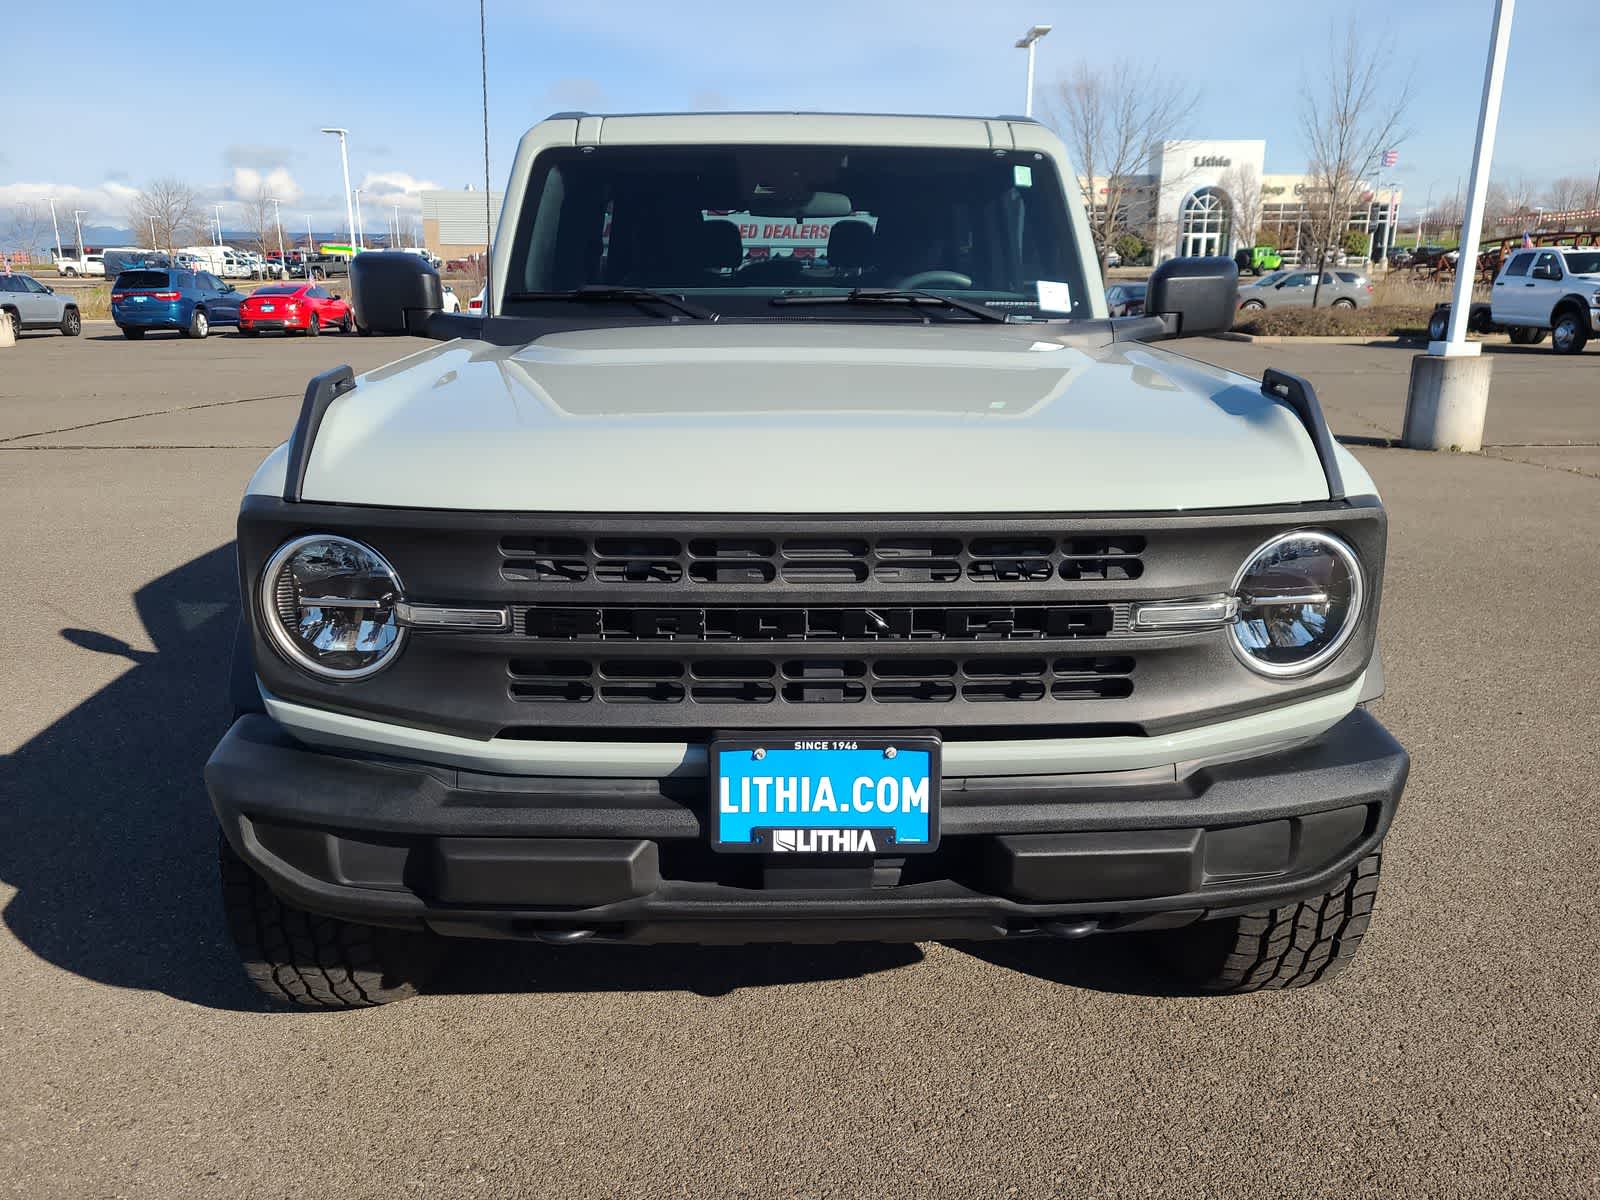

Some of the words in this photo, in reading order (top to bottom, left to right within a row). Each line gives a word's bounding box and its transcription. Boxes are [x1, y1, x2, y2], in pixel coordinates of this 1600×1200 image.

[1193, 155, 1232, 168] Lithia
[763, 224, 829, 239] DEALERS
[794, 741, 829, 750] SINCE
[832, 741, 858, 750] 1946
[720, 776, 929, 813] LITHIA.COM
[796, 829, 877, 852] LITHIA
